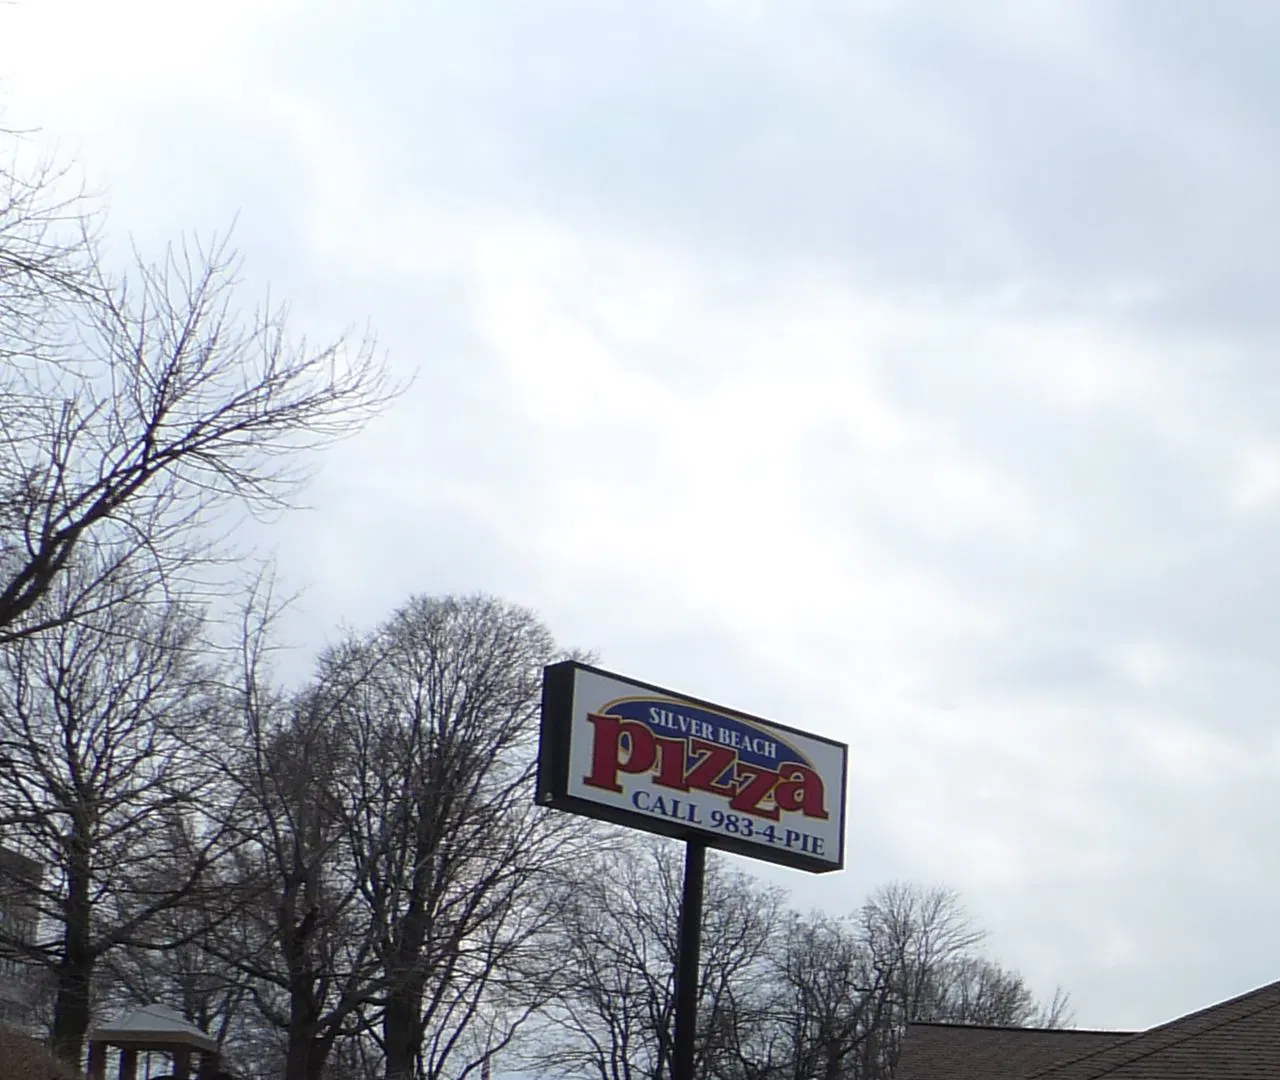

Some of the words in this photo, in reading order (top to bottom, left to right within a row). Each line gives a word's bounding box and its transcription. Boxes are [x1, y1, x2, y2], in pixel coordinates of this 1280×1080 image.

[649, 707, 713, 740] SILVER
[718, 728, 777, 759] BEACH
[631, 790, 703, 824] CALL
[710, 810, 826, 856] 983-4-PIE
